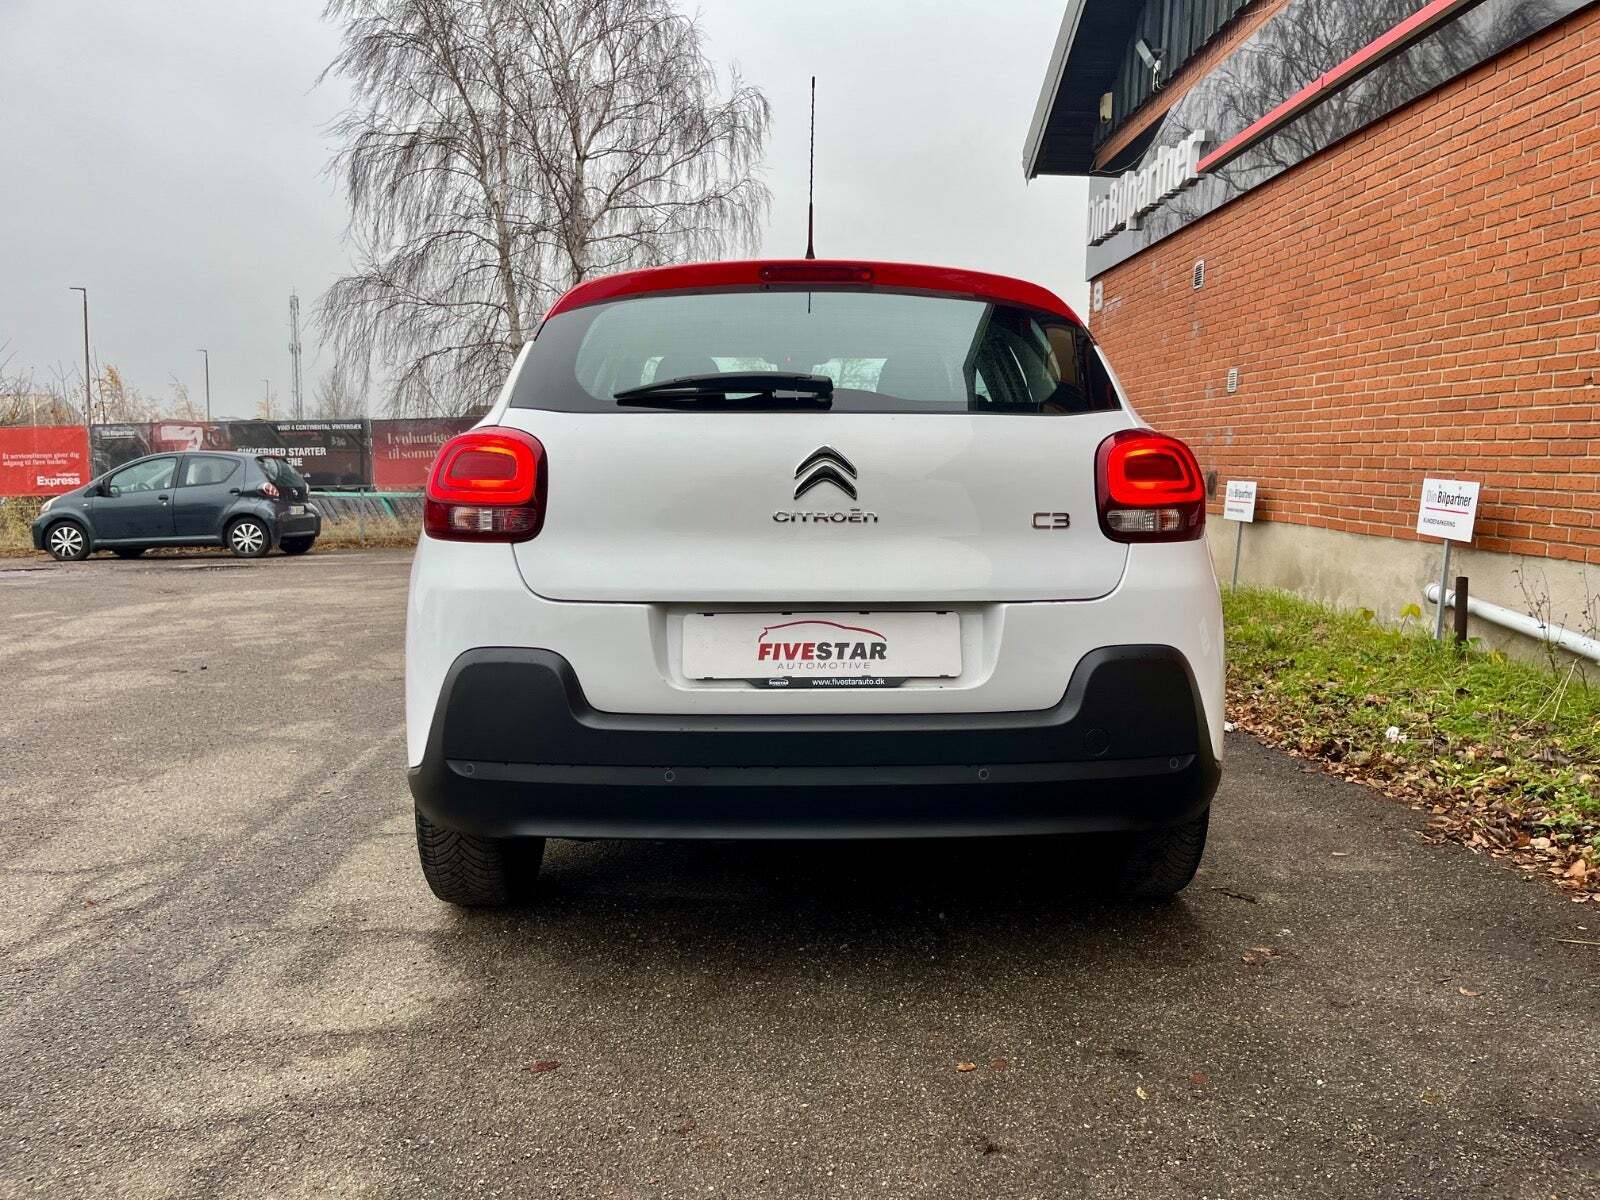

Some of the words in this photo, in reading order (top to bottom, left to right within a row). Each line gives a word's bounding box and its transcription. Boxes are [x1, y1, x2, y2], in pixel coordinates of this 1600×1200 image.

[1107, 129, 1206, 230] Bilpartner
[296, 423, 331, 431] CONTINENTAL
[288, 447, 327, 457] STARTER
[388, 445, 400, 460] til
[36, 475, 81, 487] Express
[1437, 490, 1472, 507] Bilpartner
[1030, 512, 1071, 529] C3
[757, 642, 888, 661] FIVESTAR
[776, 661, 872, 670] AUTOMOTIVE
[812, 678, 885, 686] www.fivestarauto.dk
